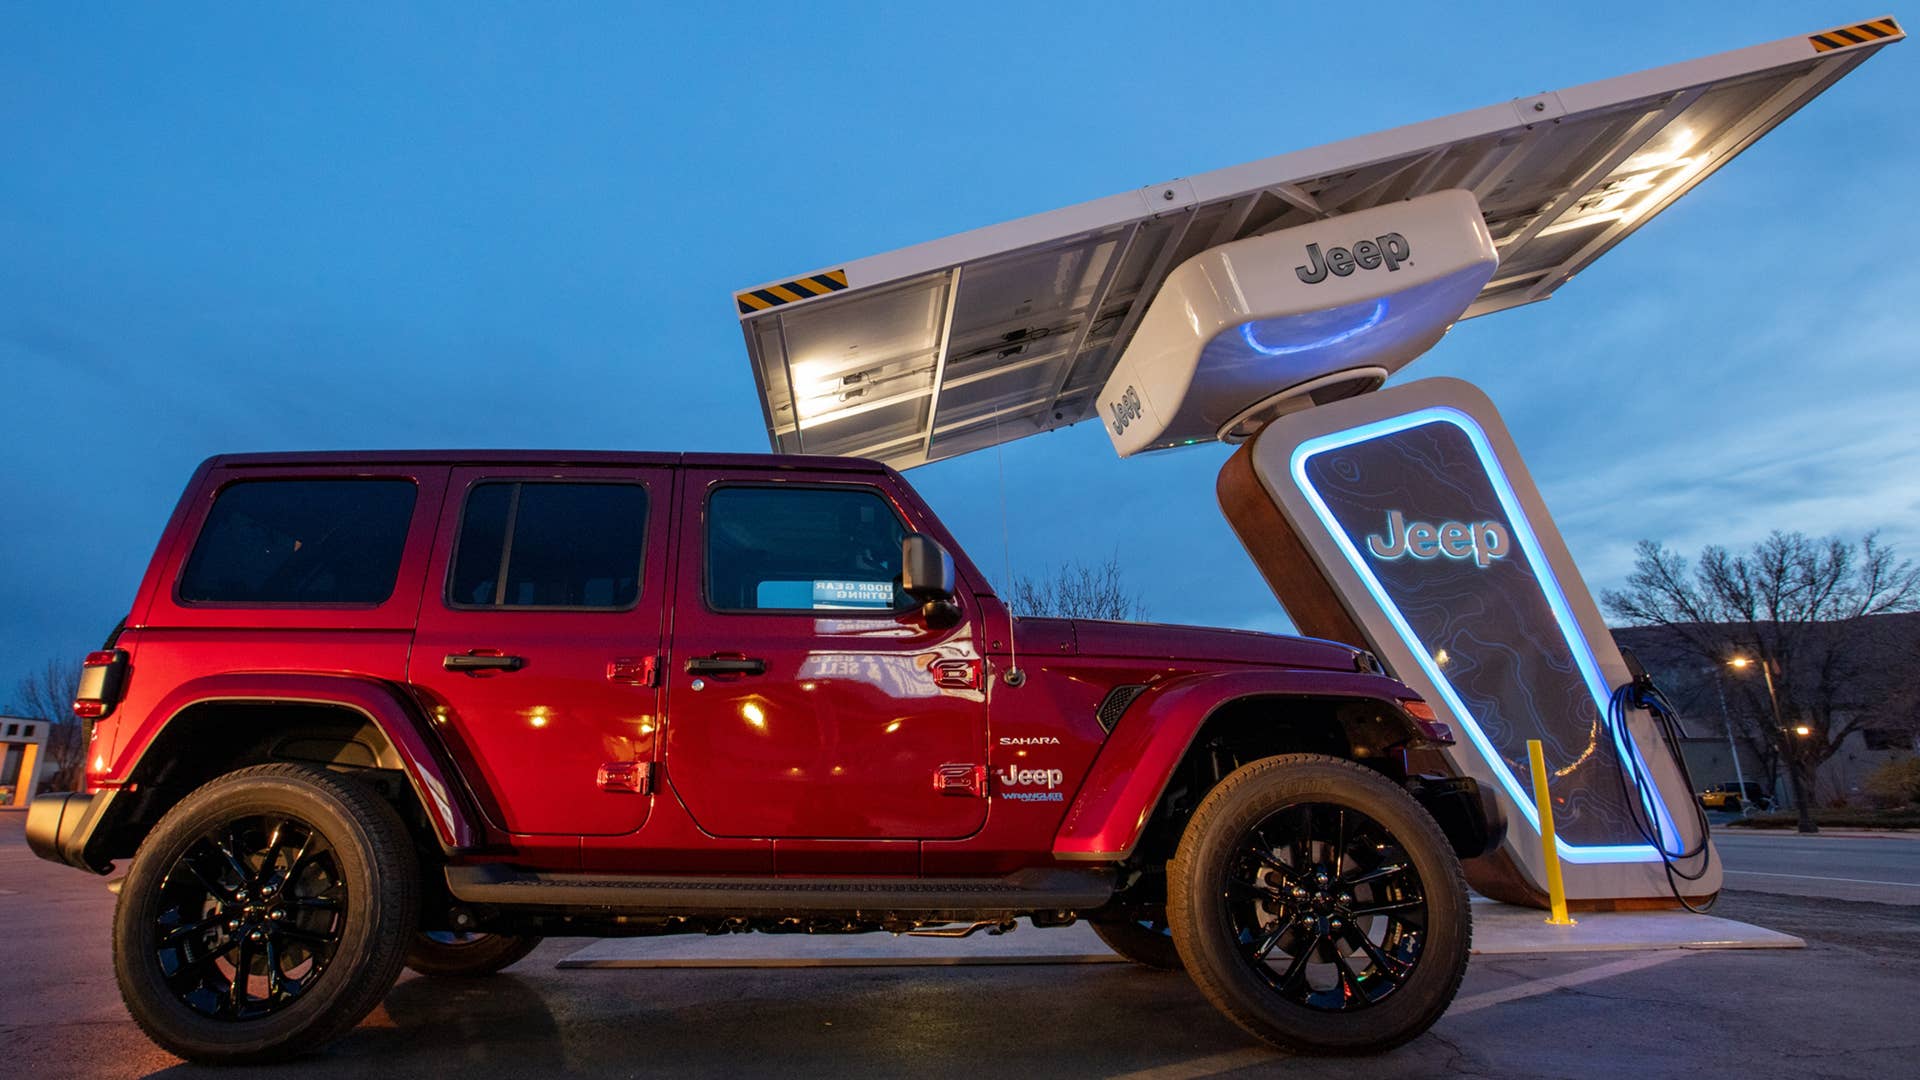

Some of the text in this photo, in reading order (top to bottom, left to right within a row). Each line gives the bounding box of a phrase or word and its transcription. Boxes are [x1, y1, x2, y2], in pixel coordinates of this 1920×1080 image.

[1295, 232, 1410, 284] Jeep
[1110, 385, 1141, 436] Jeep
[1367, 510, 1510, 567] Jeep
[999, 737, 1060, 745] SAHARA
[1001, 764, 1063, 789] Jeep
